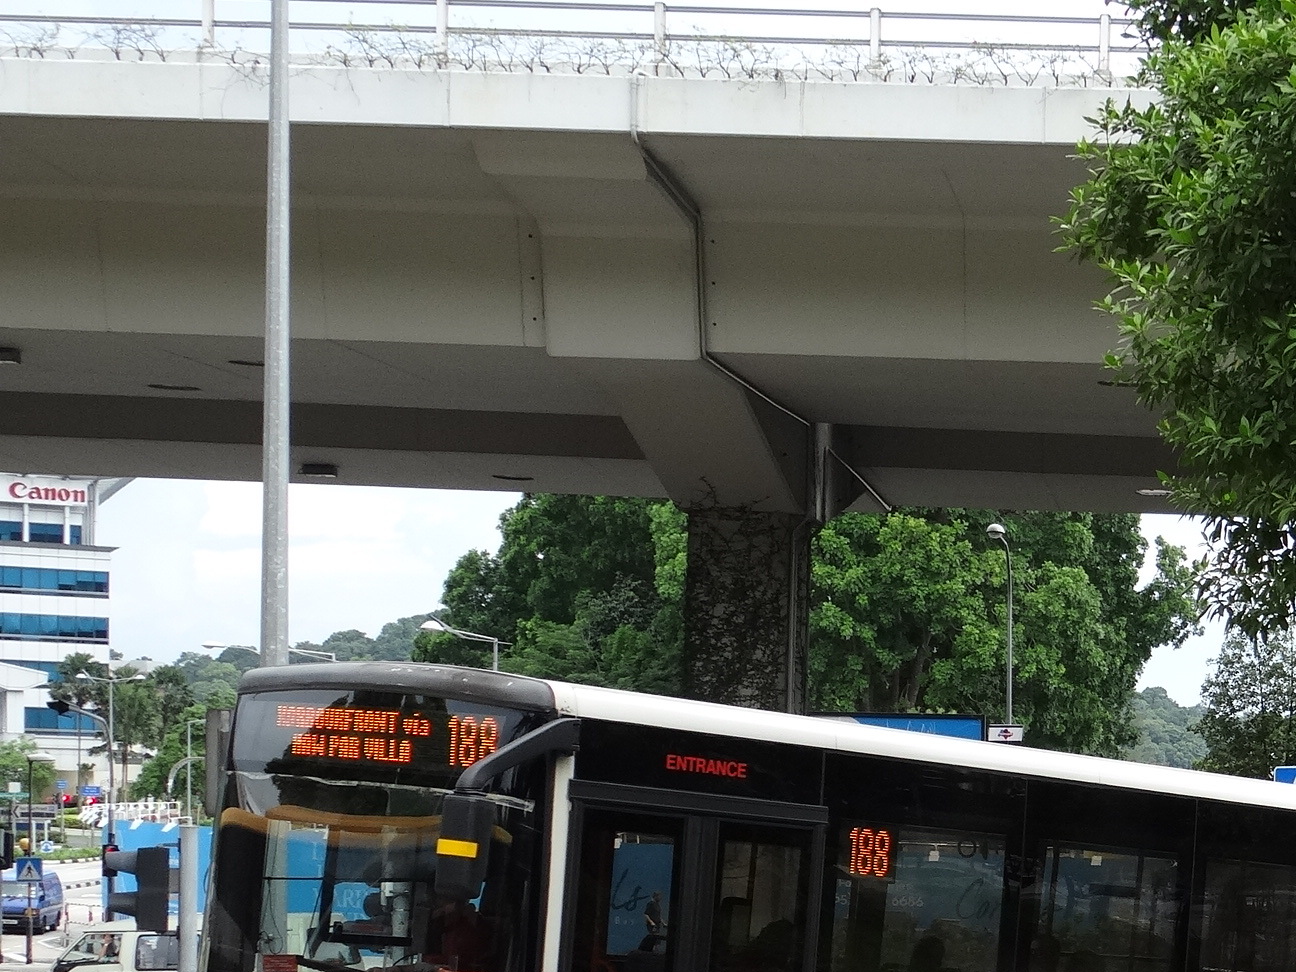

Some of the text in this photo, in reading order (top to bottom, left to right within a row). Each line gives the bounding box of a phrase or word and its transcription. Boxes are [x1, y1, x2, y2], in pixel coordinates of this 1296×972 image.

[9, 482, 86, 503] Canon
[363, 737, 413, 763] VILLA
[448, 715, 499, 768] 188
[665, 753, 748, 779] ENTRANCE
[849, 827, 891, 878] 188
